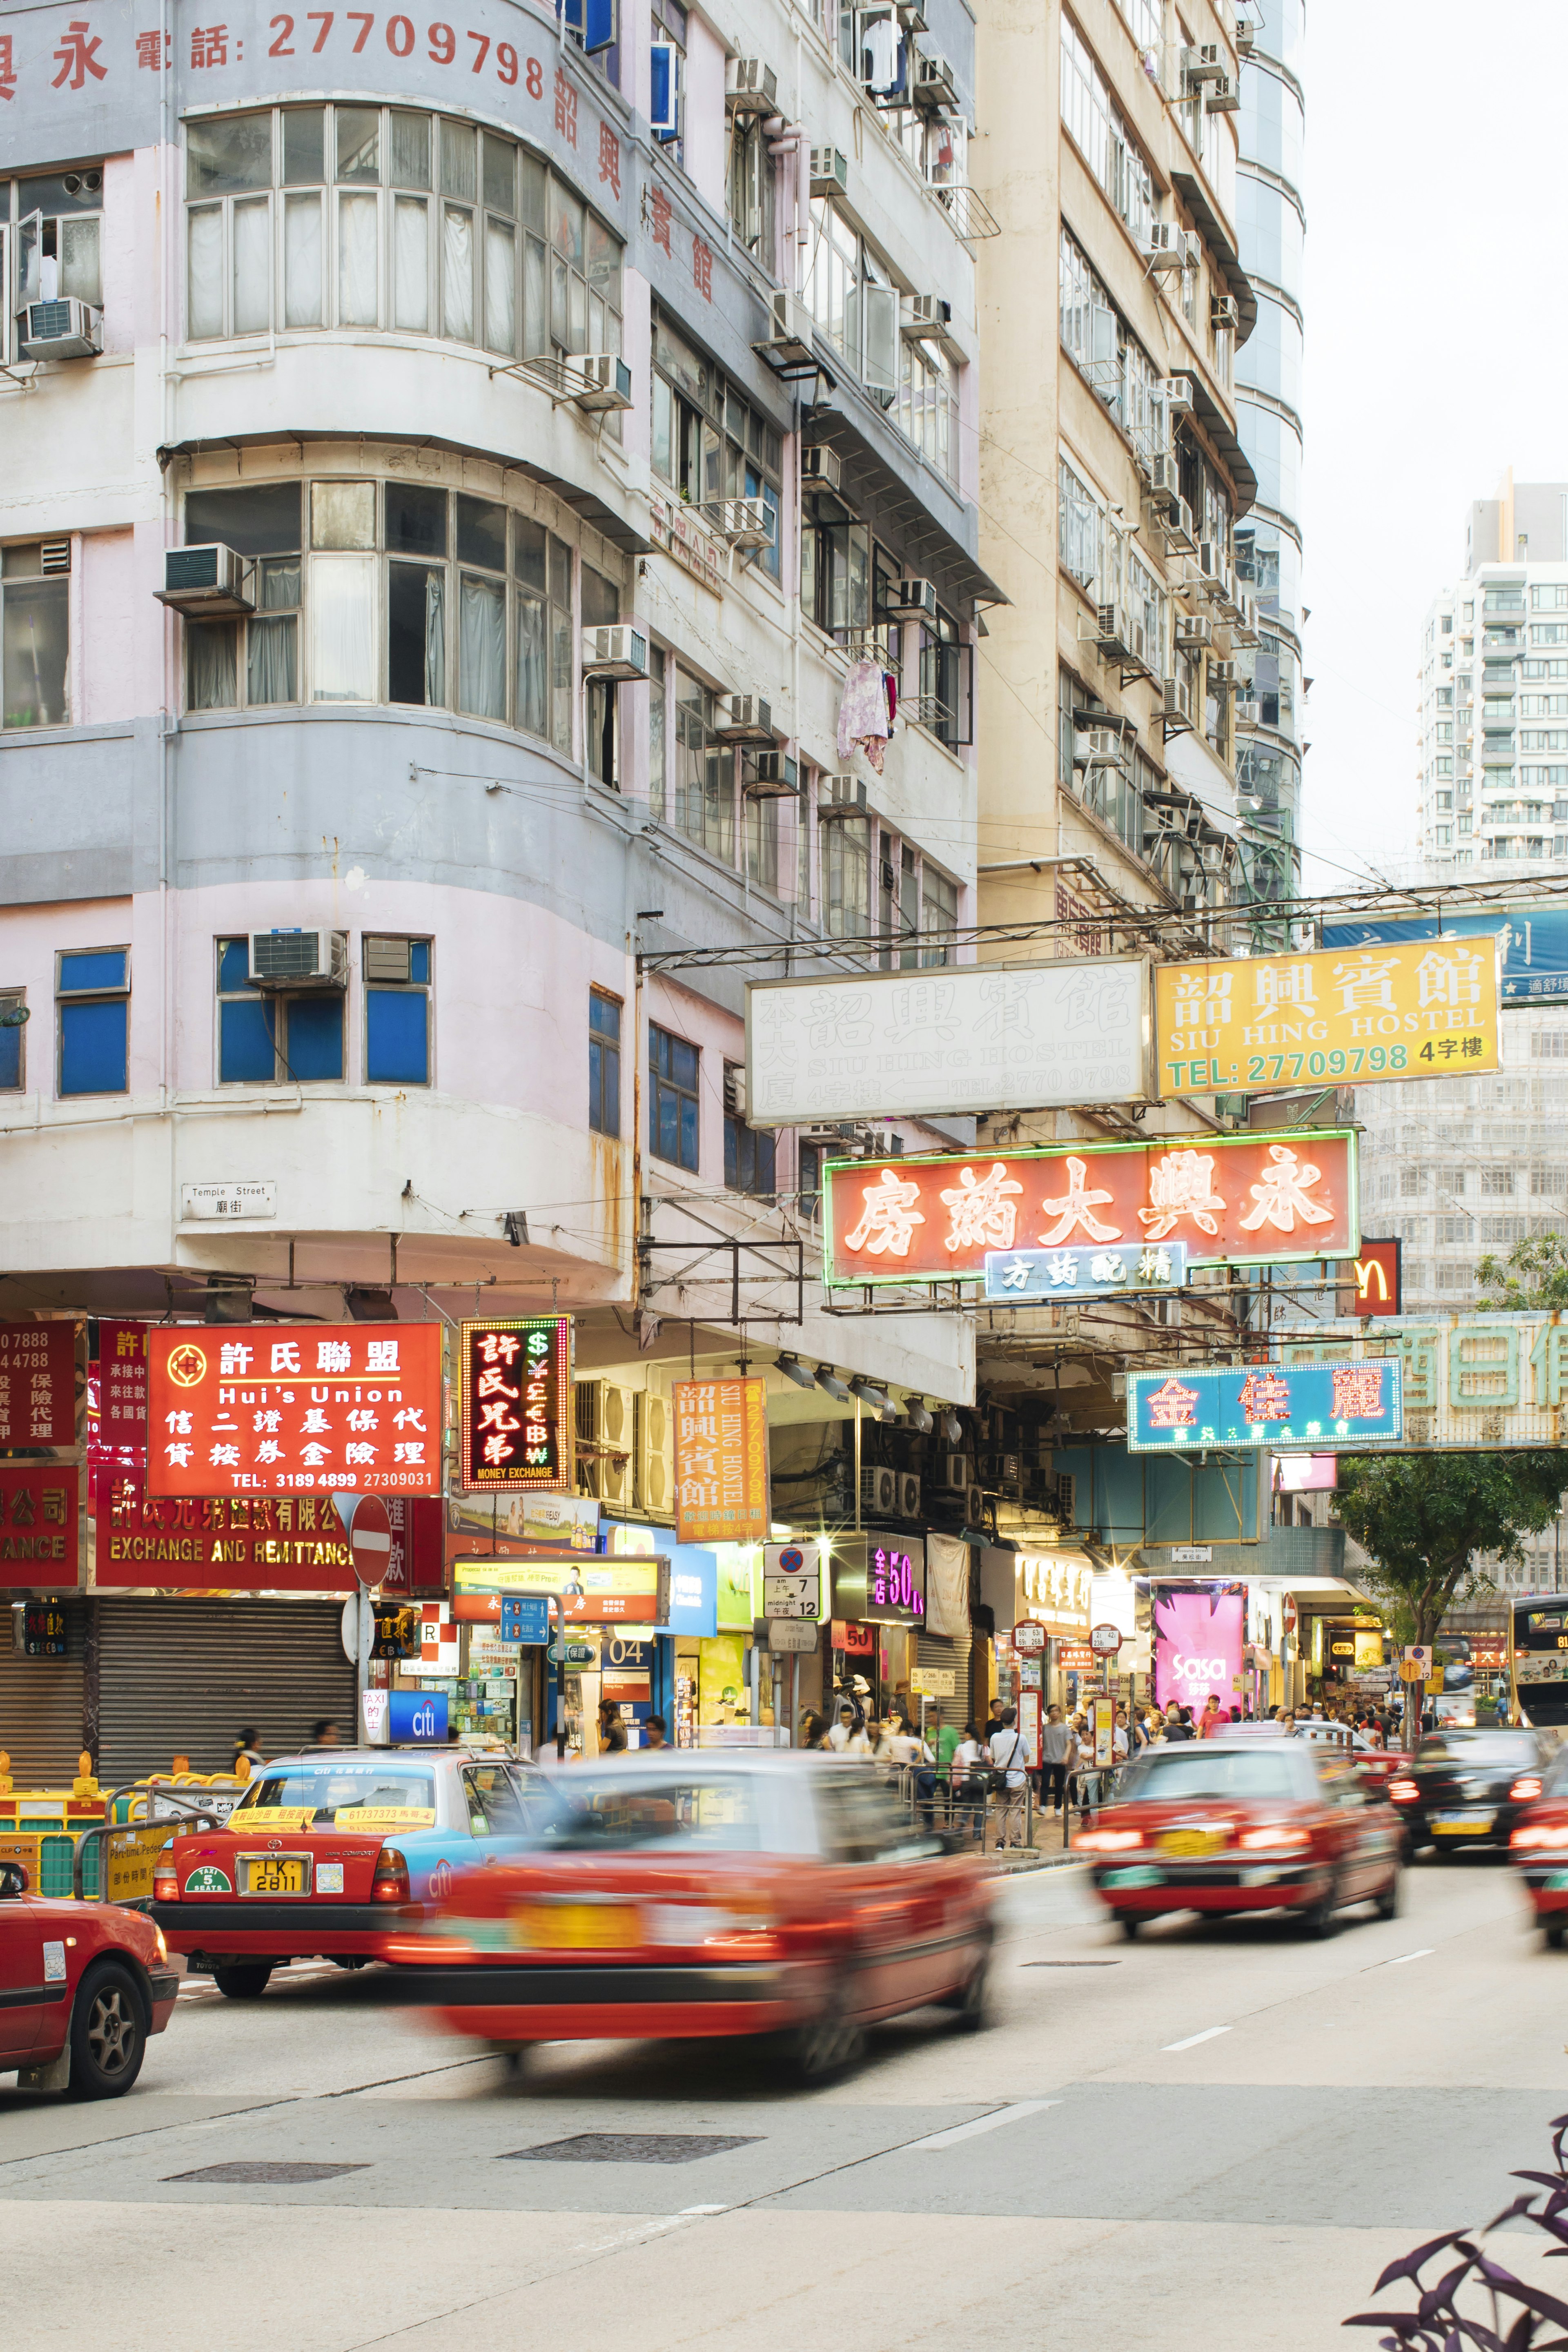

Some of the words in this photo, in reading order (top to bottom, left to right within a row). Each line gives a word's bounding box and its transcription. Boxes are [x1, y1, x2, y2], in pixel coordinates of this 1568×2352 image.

[269, 12, 543, 100] 27709798
[553, 67, 713, 305] 韶興賓館
[1170, 948, 1485, 1027] 韶興賓館
[801, 966, 1136, 1050] 韶興賓館
[1171, 1029, 1221, 1052] SIU
[1243, 1020, 1329, 1046] HING
[1350, 1008, 1484, 1037] HOSTEL
[760, 991, 797, 1109] 本大廈
[808, 1055, 873, 1077] SIU
[876, 1047, 972, 1073] HING
[980, 1038, 1131, 1067] HOSTEL
[1419, 1036, 1483, 1062] 4字樓
[1167, 1059, 1237, 1088] TEL:
[1247, 1044, 1407, 1082] 27709798
[807, 1079, 882, 1107] 4字樓
[193, 1188, 225, 1197] Temple
[216, 1201, 241, 1213] 廟街
[13, 1332, 48, 1348] 7888
[13, 1353, 48, 1368] 4788
[220, 1341, 401, 1374] 許氏聯盟
[311, 1386, 403, 1403] Union
[478, 1334, 521, 1465] 許氏兄弟
[721, 1385, 740, 1405] SIU
[30, 1374, 53, 1438] 保險代理
[722, 1414, 742, 1448] HING
[677, 1385, 720, 1507] 韶興賓館
[747, 1405, 762, 1503] 27709798
[231, 1474, 267, 1488] TEL:
[276, 1474, 315, 1488] 3189
[318, 1473, 357, 1487] 4899
[363, 1472, 432, 1486] 27309031
[478, 1468, 506, 1479] MONEY
[509, 1467, 553, 1479] EXCHANGE
[722, 1455, 743, 1506] HOSTEL
[684, 1508, 762, 1522] 歡迎時鐘日租
[693, 1522, 753, 1537] 電梯按4字
[110, 1537, 203, 1561] EXCHANGE
[211, 1539, 246, 1562] AND
[774, 1585, 790, 1593] 上午
[799, 1579, 808, 1593] 7
[774, 1607, 790, 1615] 午夜
[800, 1602, 816, 1615] 12
[848, 1630, 868, 1646] 50
[609, 1640, 643, 1664] 04
[1172, 1654, 1226, 1680] Sasa
[363, 1694, 384, 1704] TAXI
[1189, 1682, 1210, 1696] 莎莎
[368, 1706, 379, 1729] 的士
[412, 1707, 434, 1737] citi
[232, 1809, 273, 1822] 馬鞍山沙田
[350, 1809, 396, 1820] 61737373
[399, 1810, 420, 1818] 馬哥
[264, 1861, 286, 1876] LK
[203, 1875, 212, 1886] 5
[257, 1876, 295, 1891] 2811
